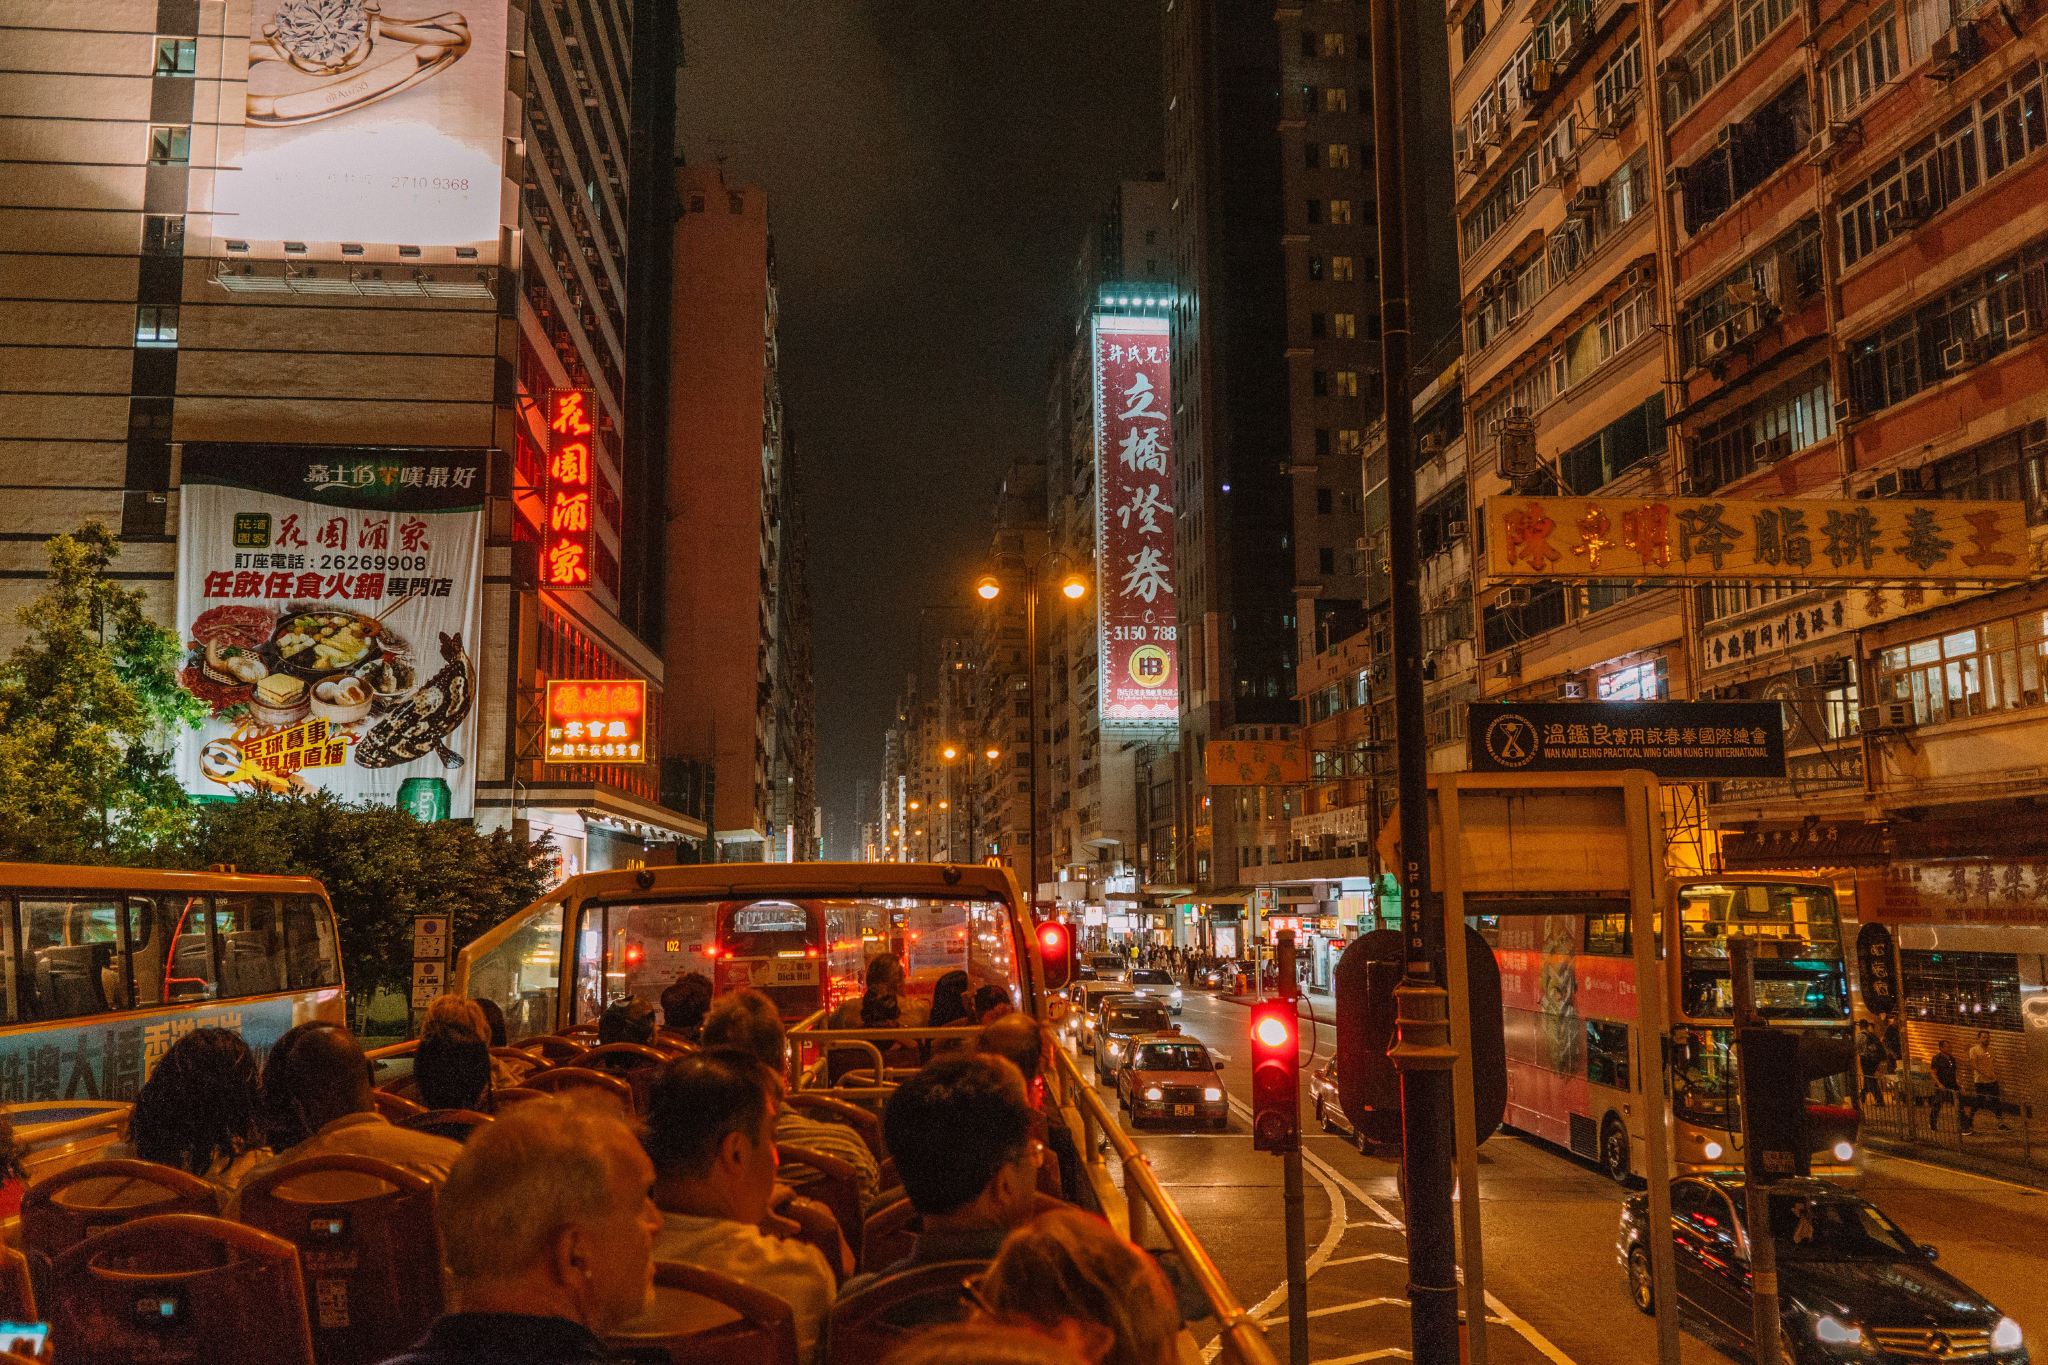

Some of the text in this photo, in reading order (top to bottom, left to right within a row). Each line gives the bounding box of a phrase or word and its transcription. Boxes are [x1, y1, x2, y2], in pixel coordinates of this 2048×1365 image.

[392, 176, 469, 191] 2710 9368
[550, 393, 591, 584] 花園酒家
[275, 513, 429, 552] 花園酒家
[320, 555, 426, 571] 26269908
[203, 570, 385, 600] 任飲任食火鍋
[1114, 626, 1146, 640] 3150
[244, 719, 327, 761] 足球賽事
[262, 742, 344, 772] 現場直播
[1544, 748, 1768, 758] WAN KAM LEUNG PRACTICAL WING CHUN KUNG FU INTERNATIONAL
[666, 940, 680, 952] 102
